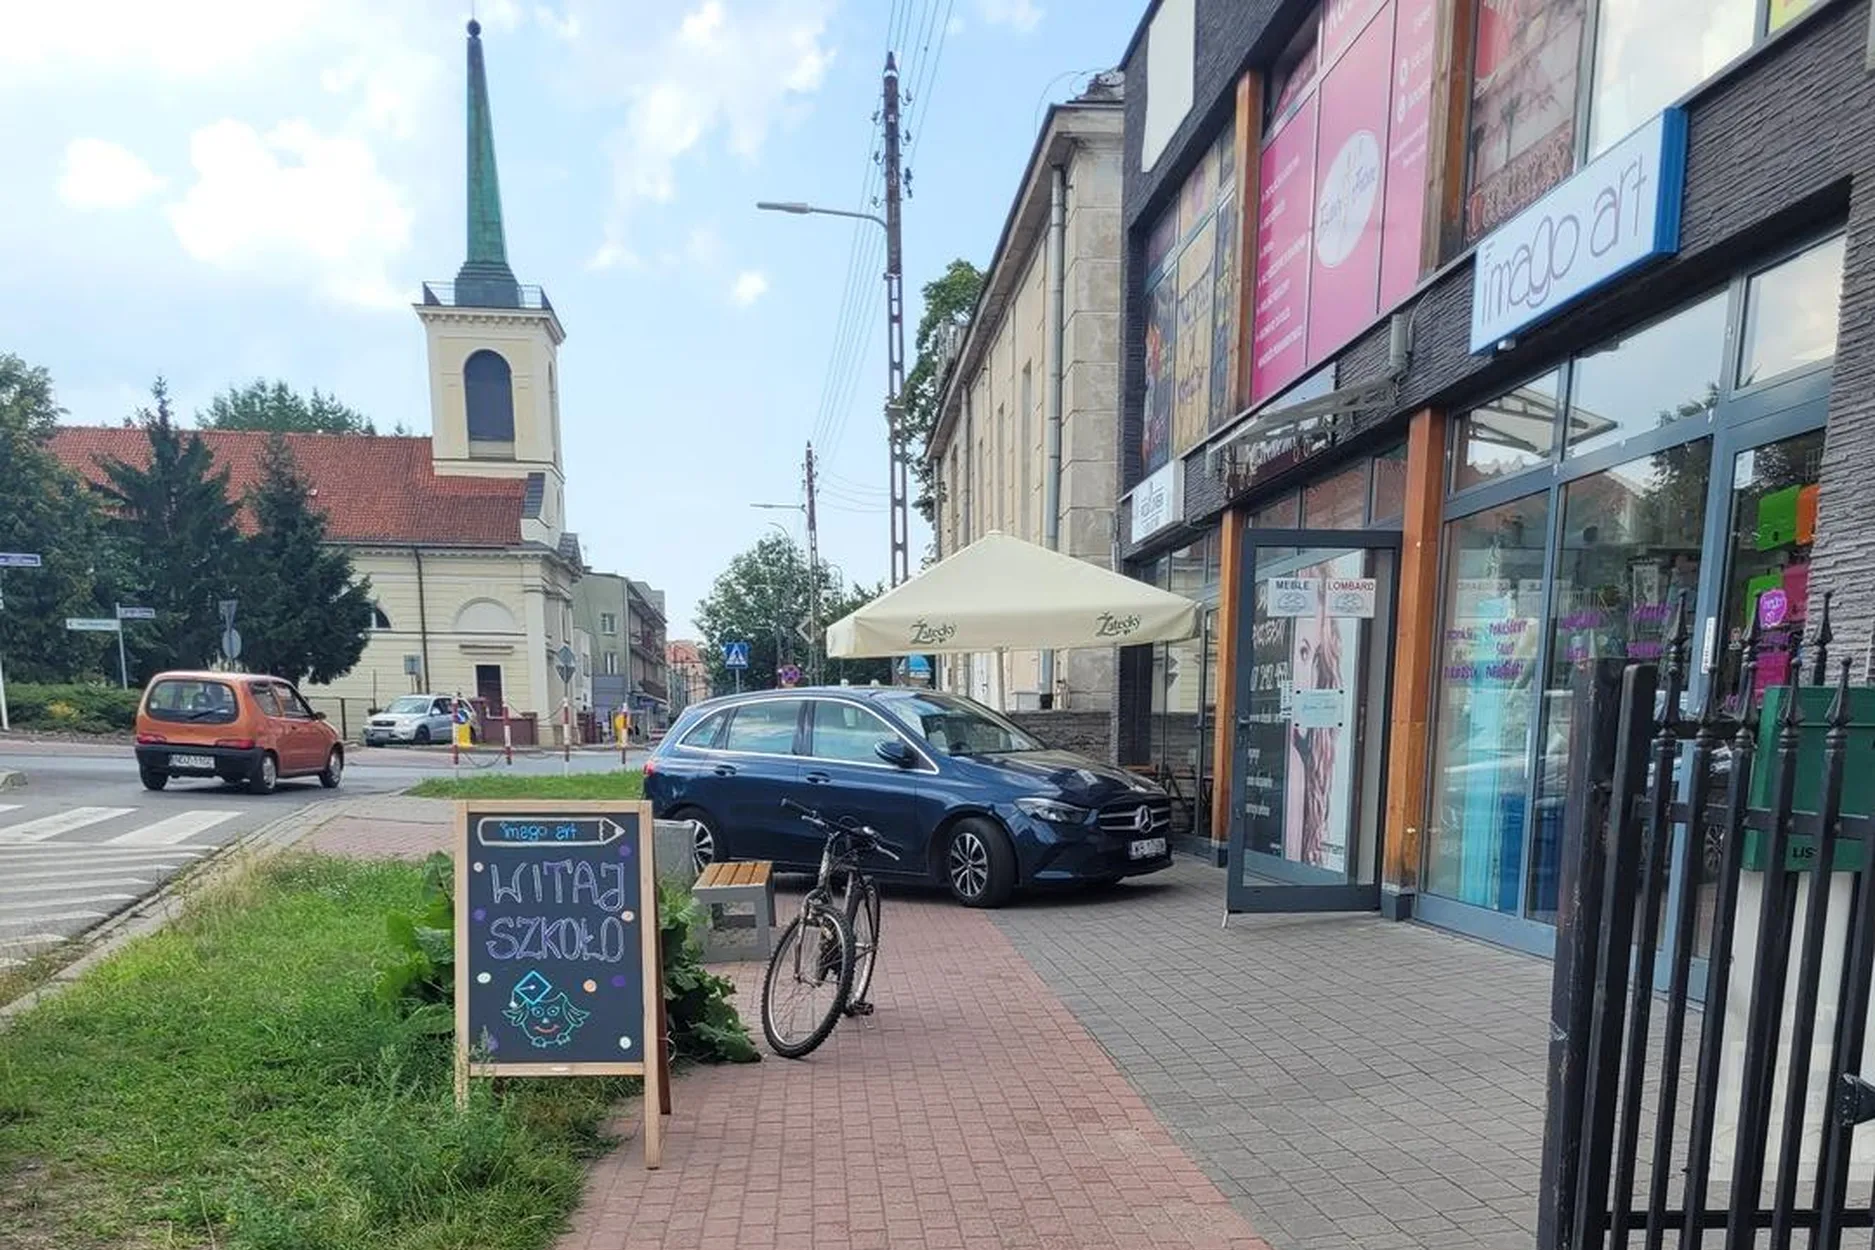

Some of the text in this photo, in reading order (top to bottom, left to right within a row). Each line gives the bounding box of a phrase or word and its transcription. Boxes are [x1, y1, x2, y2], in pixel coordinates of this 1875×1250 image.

[1481, 215, 1580, 325] imago
[1590, 153, 1648, 258] art
[1276, 580, 1311, 591] MEBLE
[1328, 580, 1374, 591] LOMBARD
[499, 820, 578, 841] imago art
[1792, 846, 1818, 859] LIS
[489, 858, 626, 913] WITAJ
[485, 915, 625, 963] SZKOŁO
